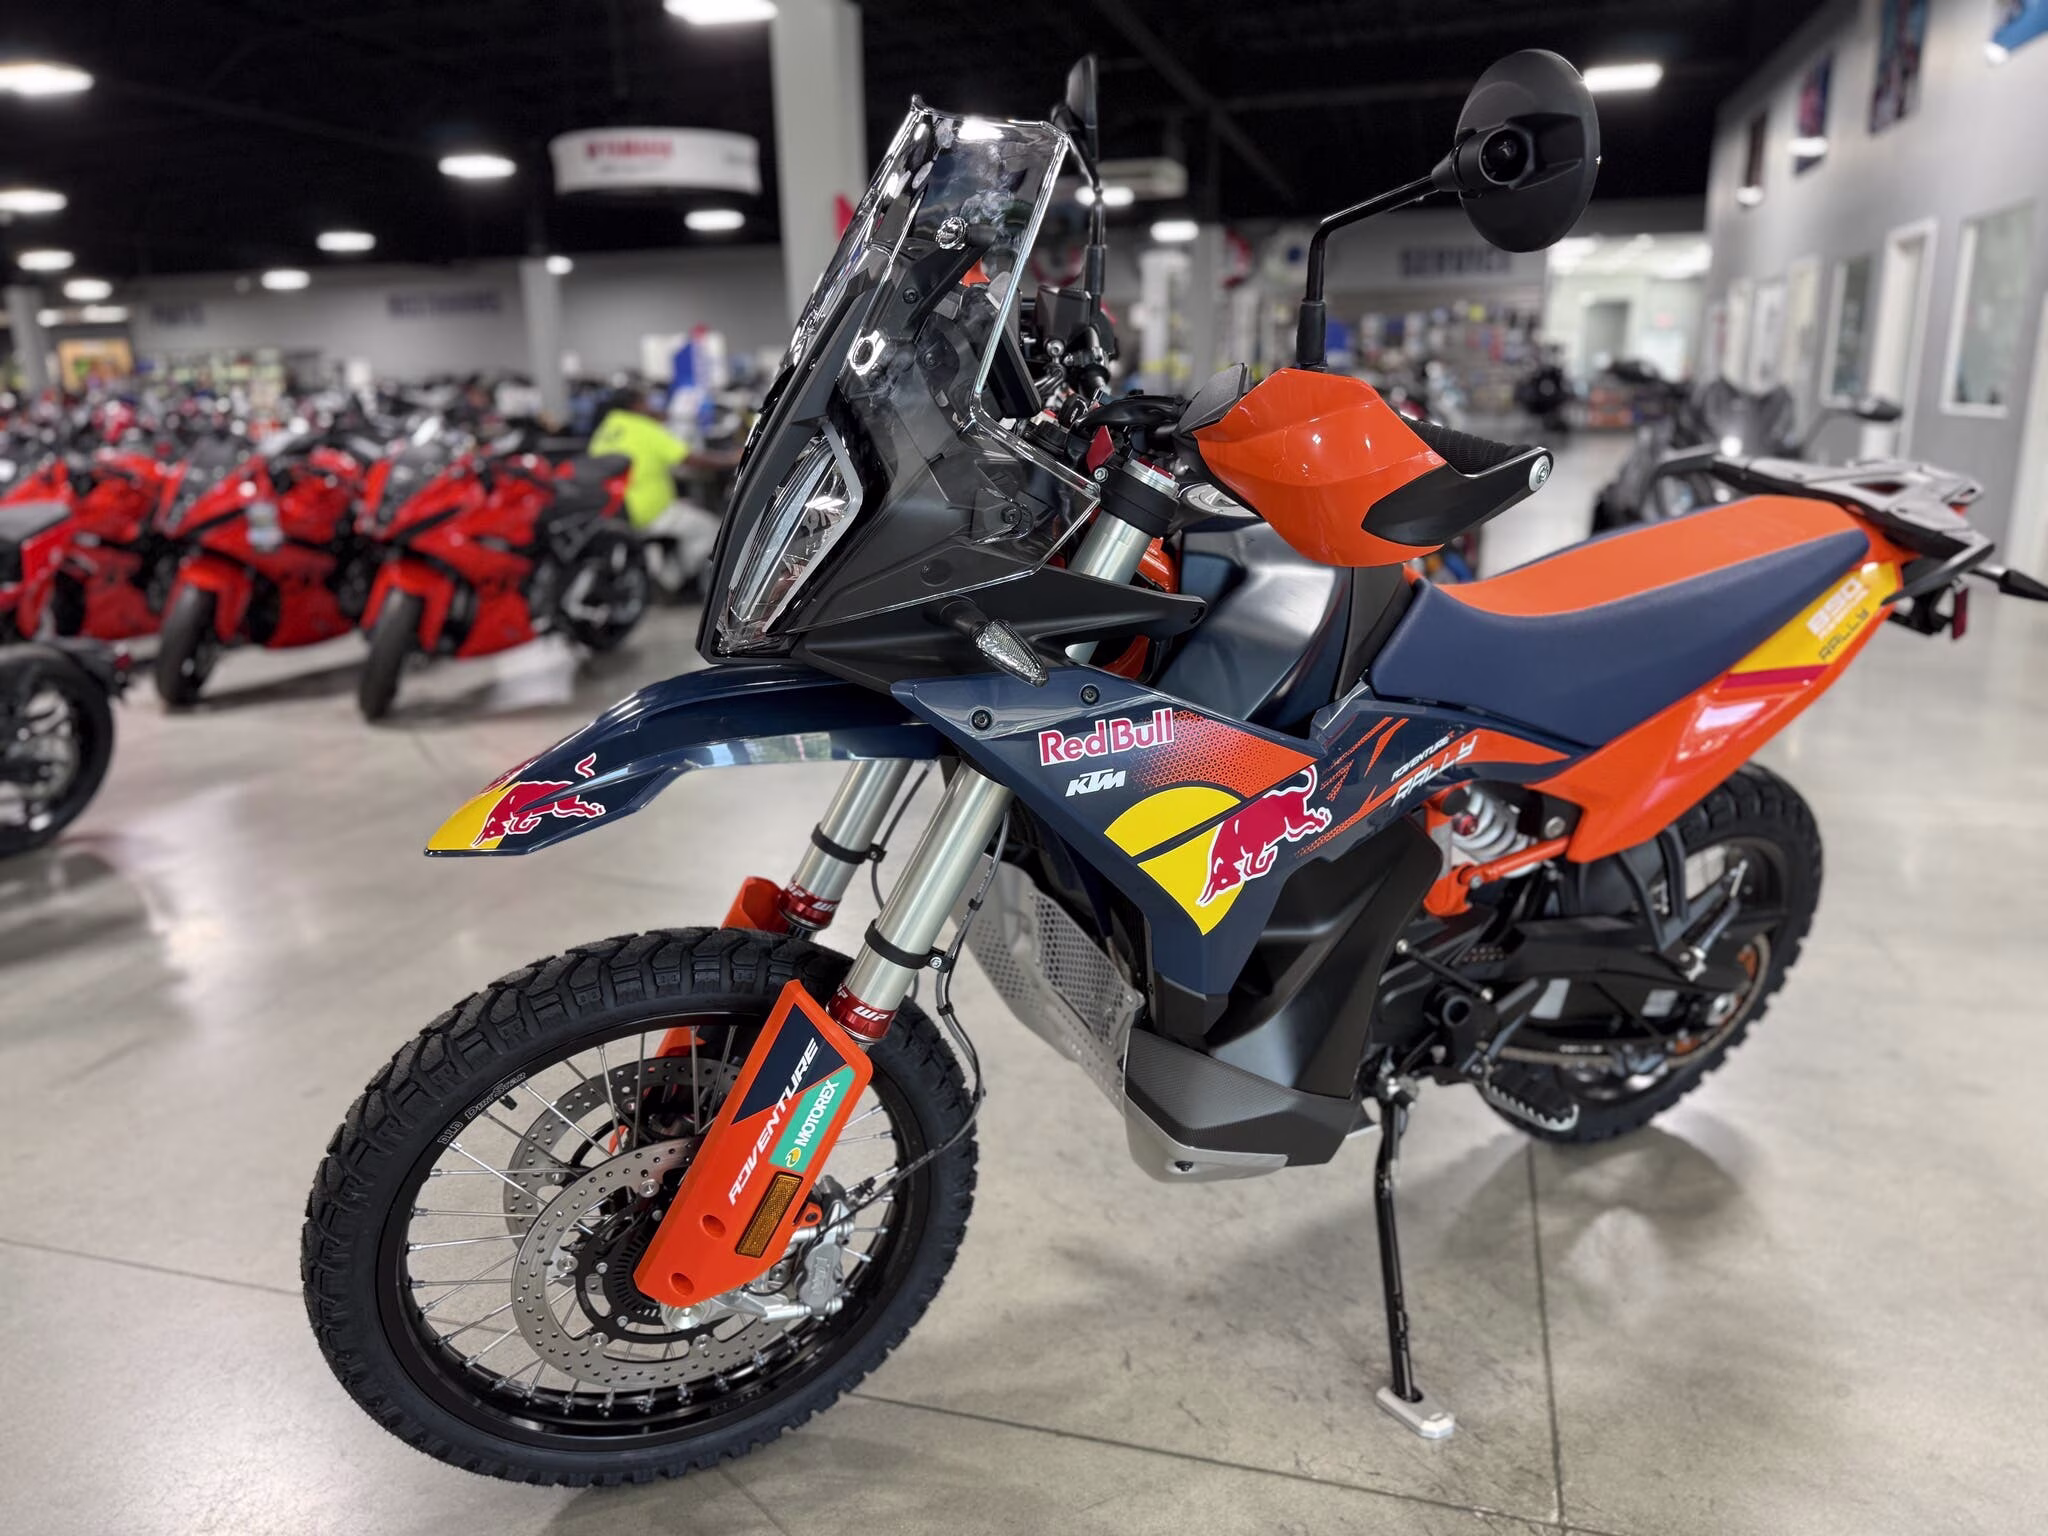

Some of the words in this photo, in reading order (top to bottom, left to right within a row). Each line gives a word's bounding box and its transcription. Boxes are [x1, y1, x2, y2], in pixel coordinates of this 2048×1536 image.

[1038, 719, 1108, 766] Red
[1109, 707, 1175, 753] Bull
[1391, 735, 1450, 782] ADVENTURE
[1065, 768, 1126, 797] KTM
[1391, 735, 1478, 808] RALLY
[852, 1005, 889, 1021] WP
[728, 1037, 819, 1206] ADVENTURE
[794, 1079, 840, 1147] MOTOREX
